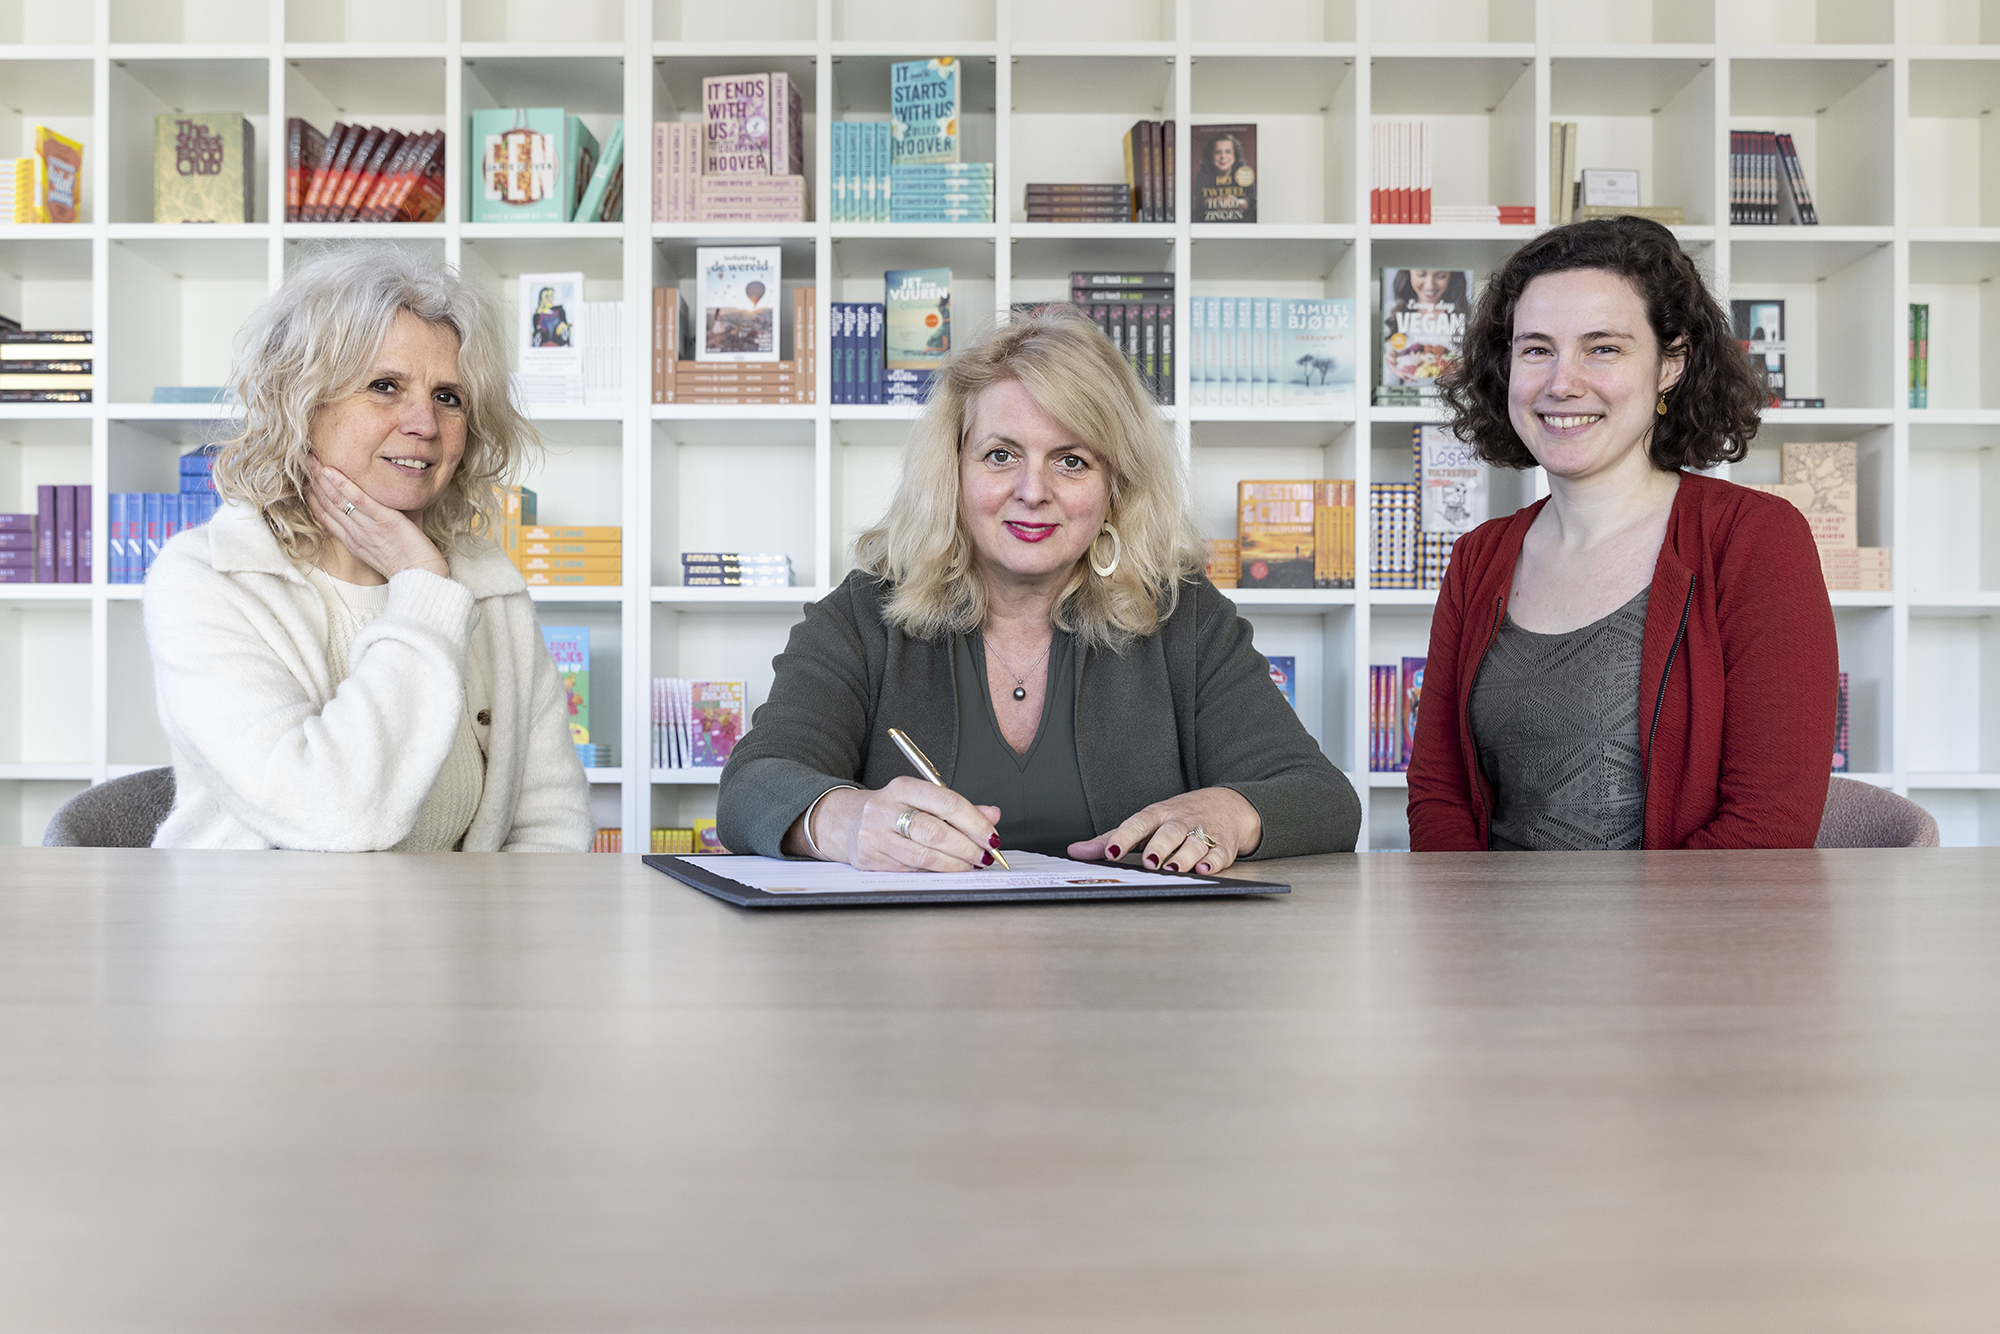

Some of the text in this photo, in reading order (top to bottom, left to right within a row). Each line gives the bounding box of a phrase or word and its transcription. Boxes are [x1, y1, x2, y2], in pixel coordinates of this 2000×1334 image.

[897, 66, 909, 83] IT
[708, 80, 764, 100] IT ENDS
[895, 81, 947, 103] STARTS
[708, 102, 747, 119] WITH
[895, 101, 953, 122] WITH US
[175, 119, 209, 140] The
[708, 122, 727, 140] US
[896, 136, 952, 156] HOOVER
[176, 158, 222, 176] Club
[485, 133, 554, 200] EEN
[709, 155, 766, 171] HOOVER
[711, 260, 769, 273] de wereld
[901, 277, 922, 290] JET
[890, 288, 948, 301] VUUREN
[1288, 303, 1350, 316] SAMUEL
[1407, 298, 1435, 312] Every
[1288, 315, 1349, 329] BJØRK
[1396, 312, 1466, 335] VEGAN
[1429, 446, 1473, 467] Lose
[1243, 483, 1313, 501] PRESTON
[1256, 501, 1313, 523] CHILD
